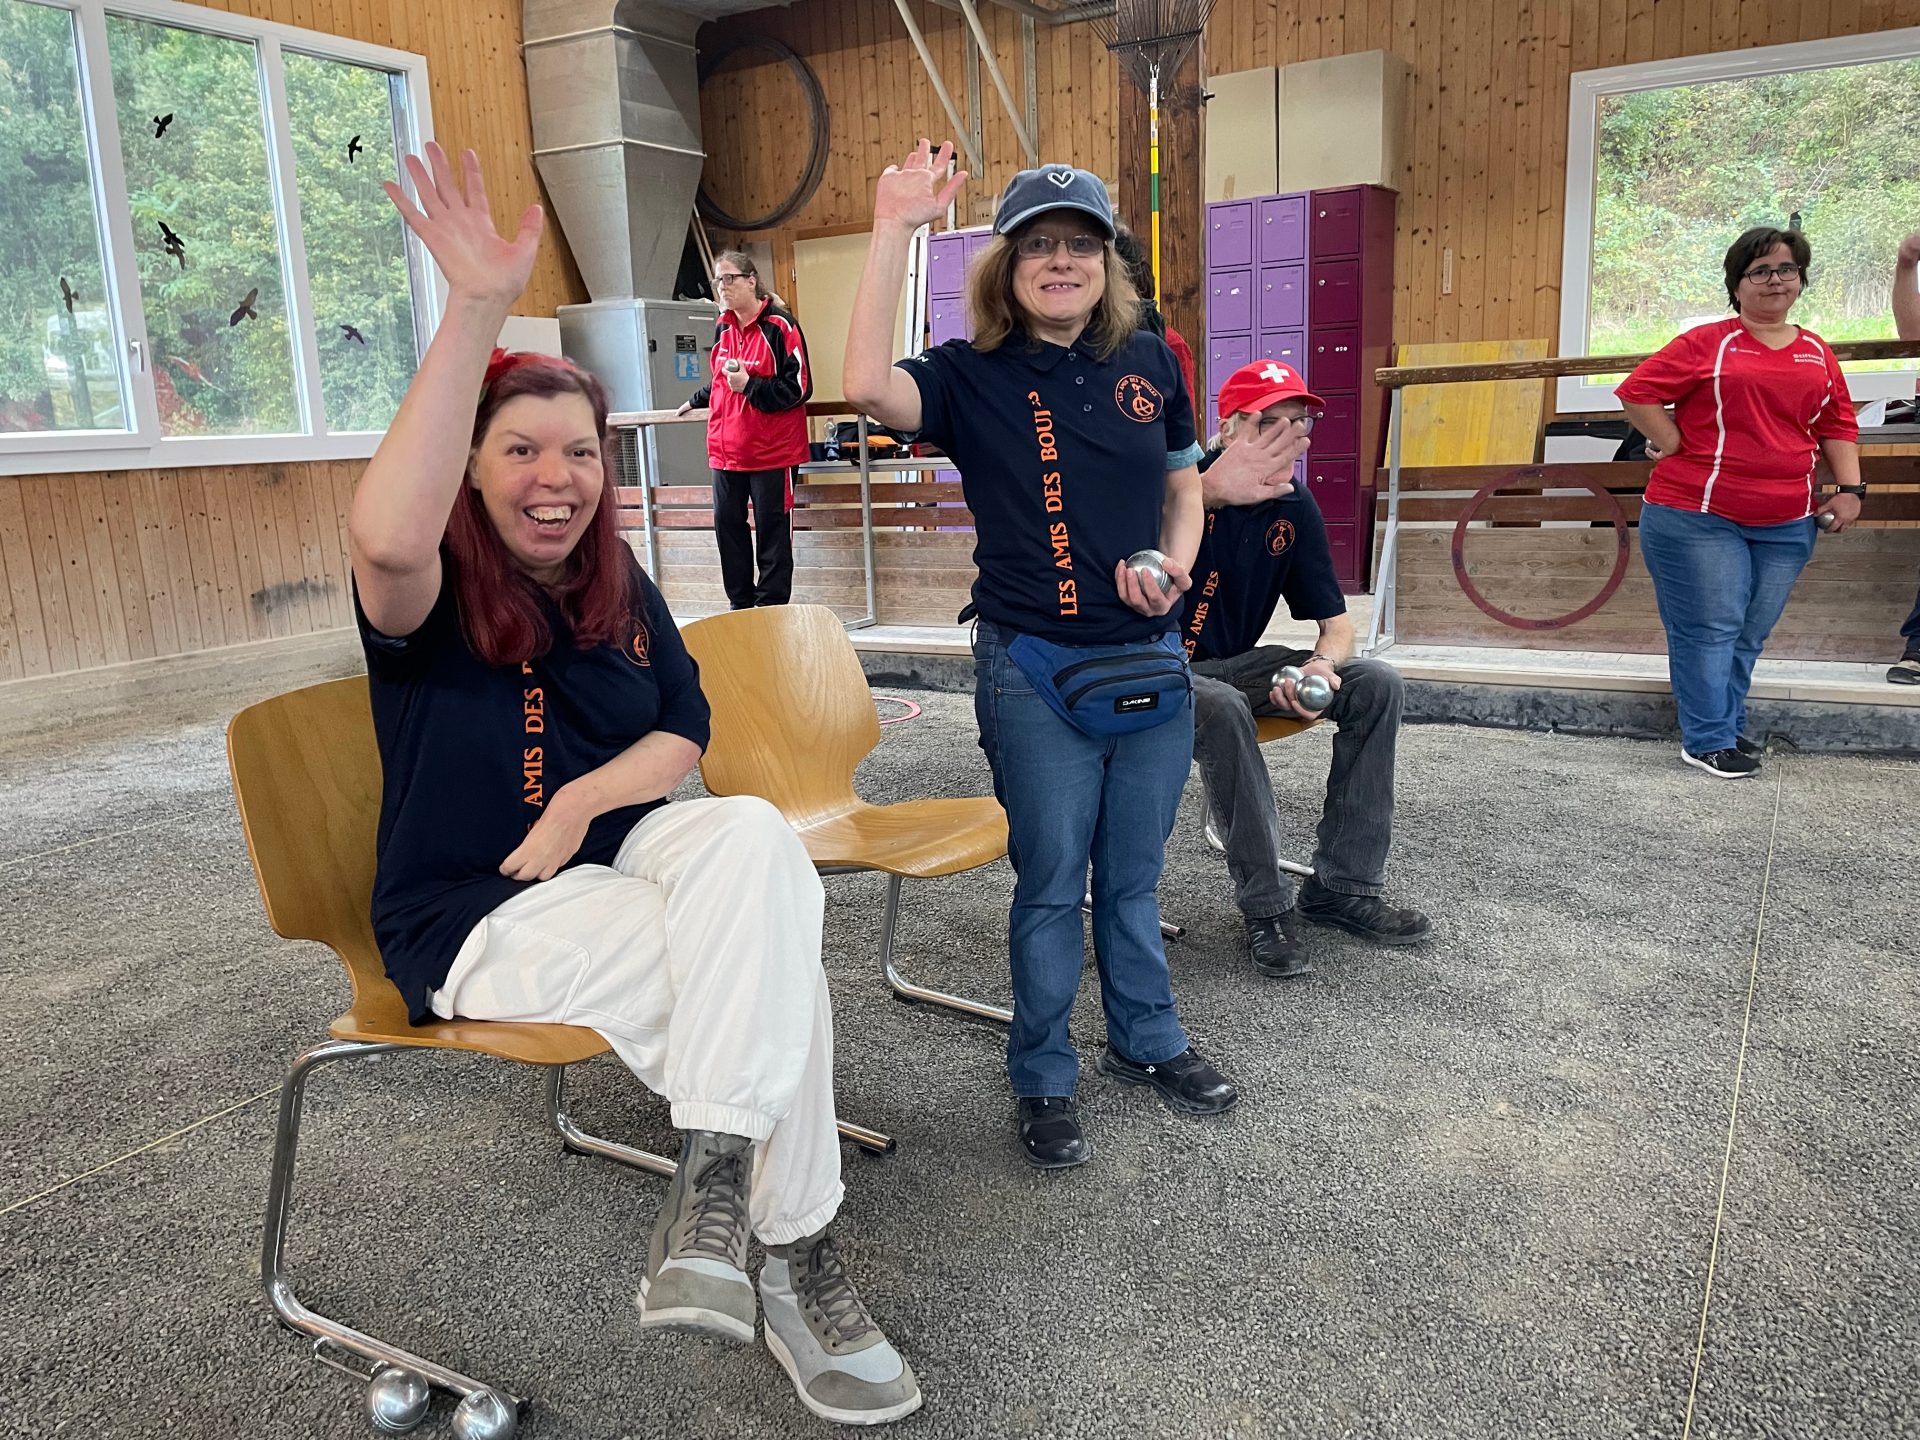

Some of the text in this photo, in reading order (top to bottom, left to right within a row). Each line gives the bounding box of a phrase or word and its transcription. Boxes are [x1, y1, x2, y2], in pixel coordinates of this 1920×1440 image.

[1042, 471, 1063, 513] DES
[1049, 521, 1073, 571] AMIS
[1058, 579, 1078, 616] LES
[1189, 601, 1209, 636] AMIS
[1202, 570, 1219, 598] DES
[524, 687, 544, 733] DES
[523, 746, 543, 807] AMIS
